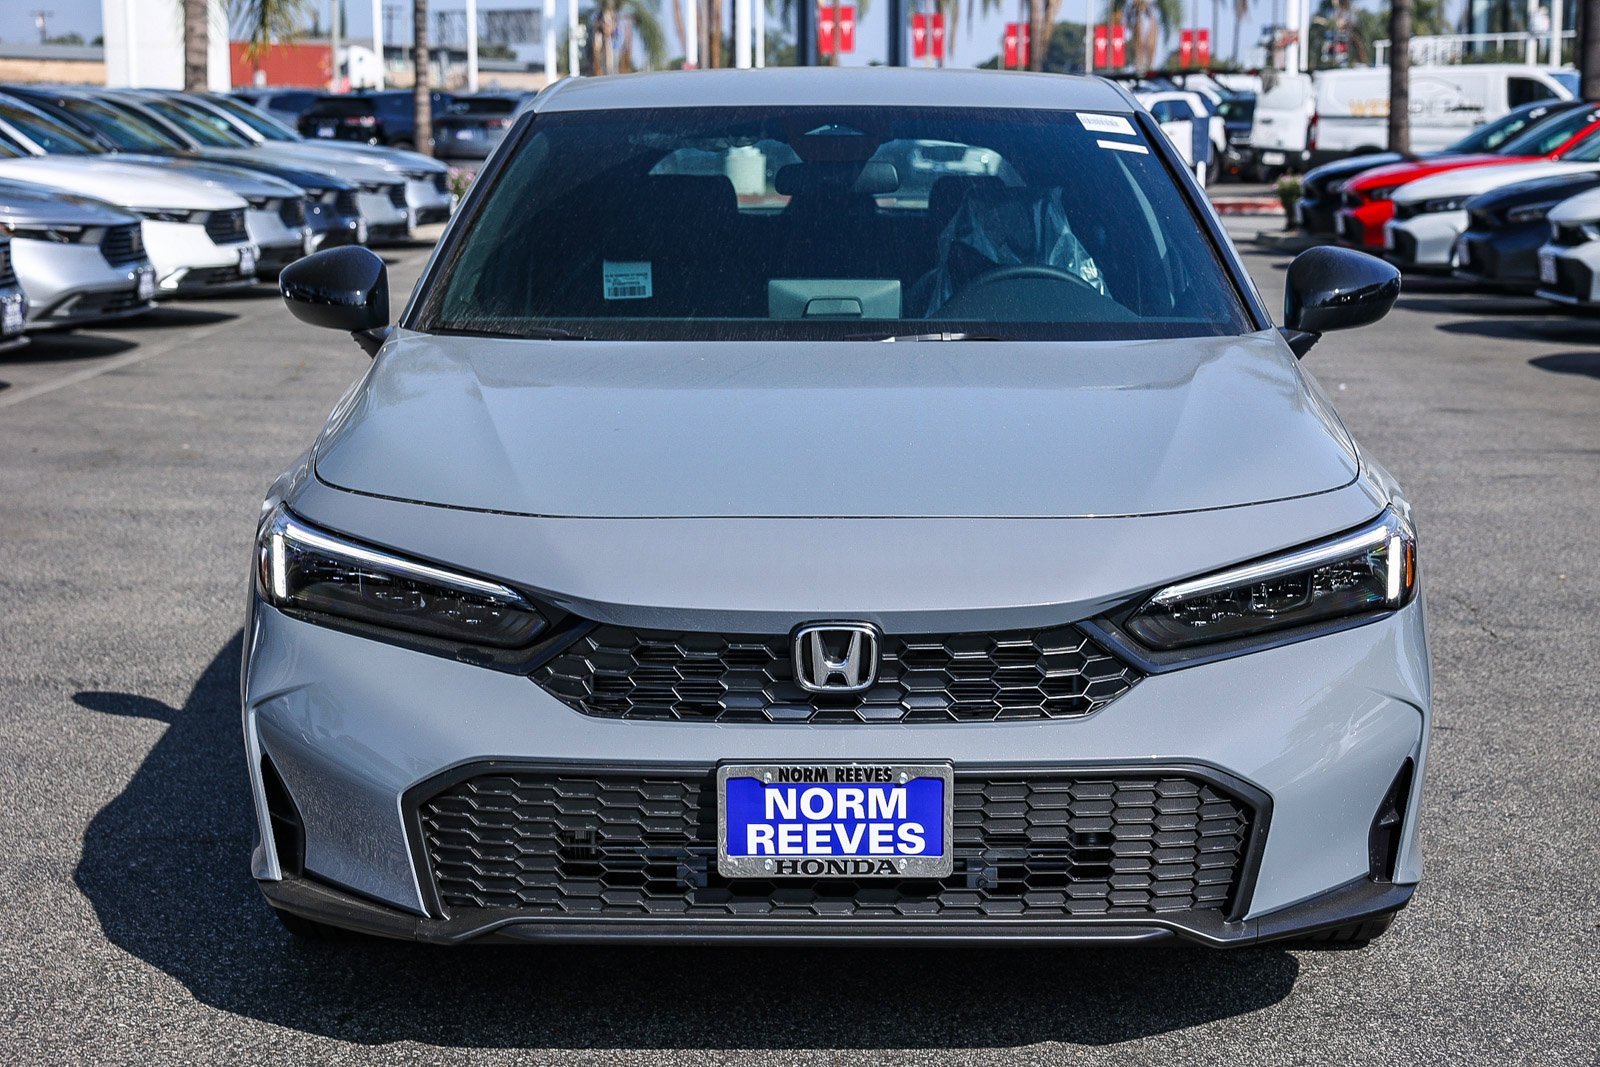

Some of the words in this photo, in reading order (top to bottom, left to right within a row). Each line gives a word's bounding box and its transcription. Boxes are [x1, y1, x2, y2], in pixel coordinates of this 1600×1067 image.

[778, 767, 828, 782] NORM
[835, 767, 892, 782] REEVES
[765, 787, 906, 820] NORM
[746, 822, 926, 855] REEVES
[775, 859, 900, 875] HONDA
